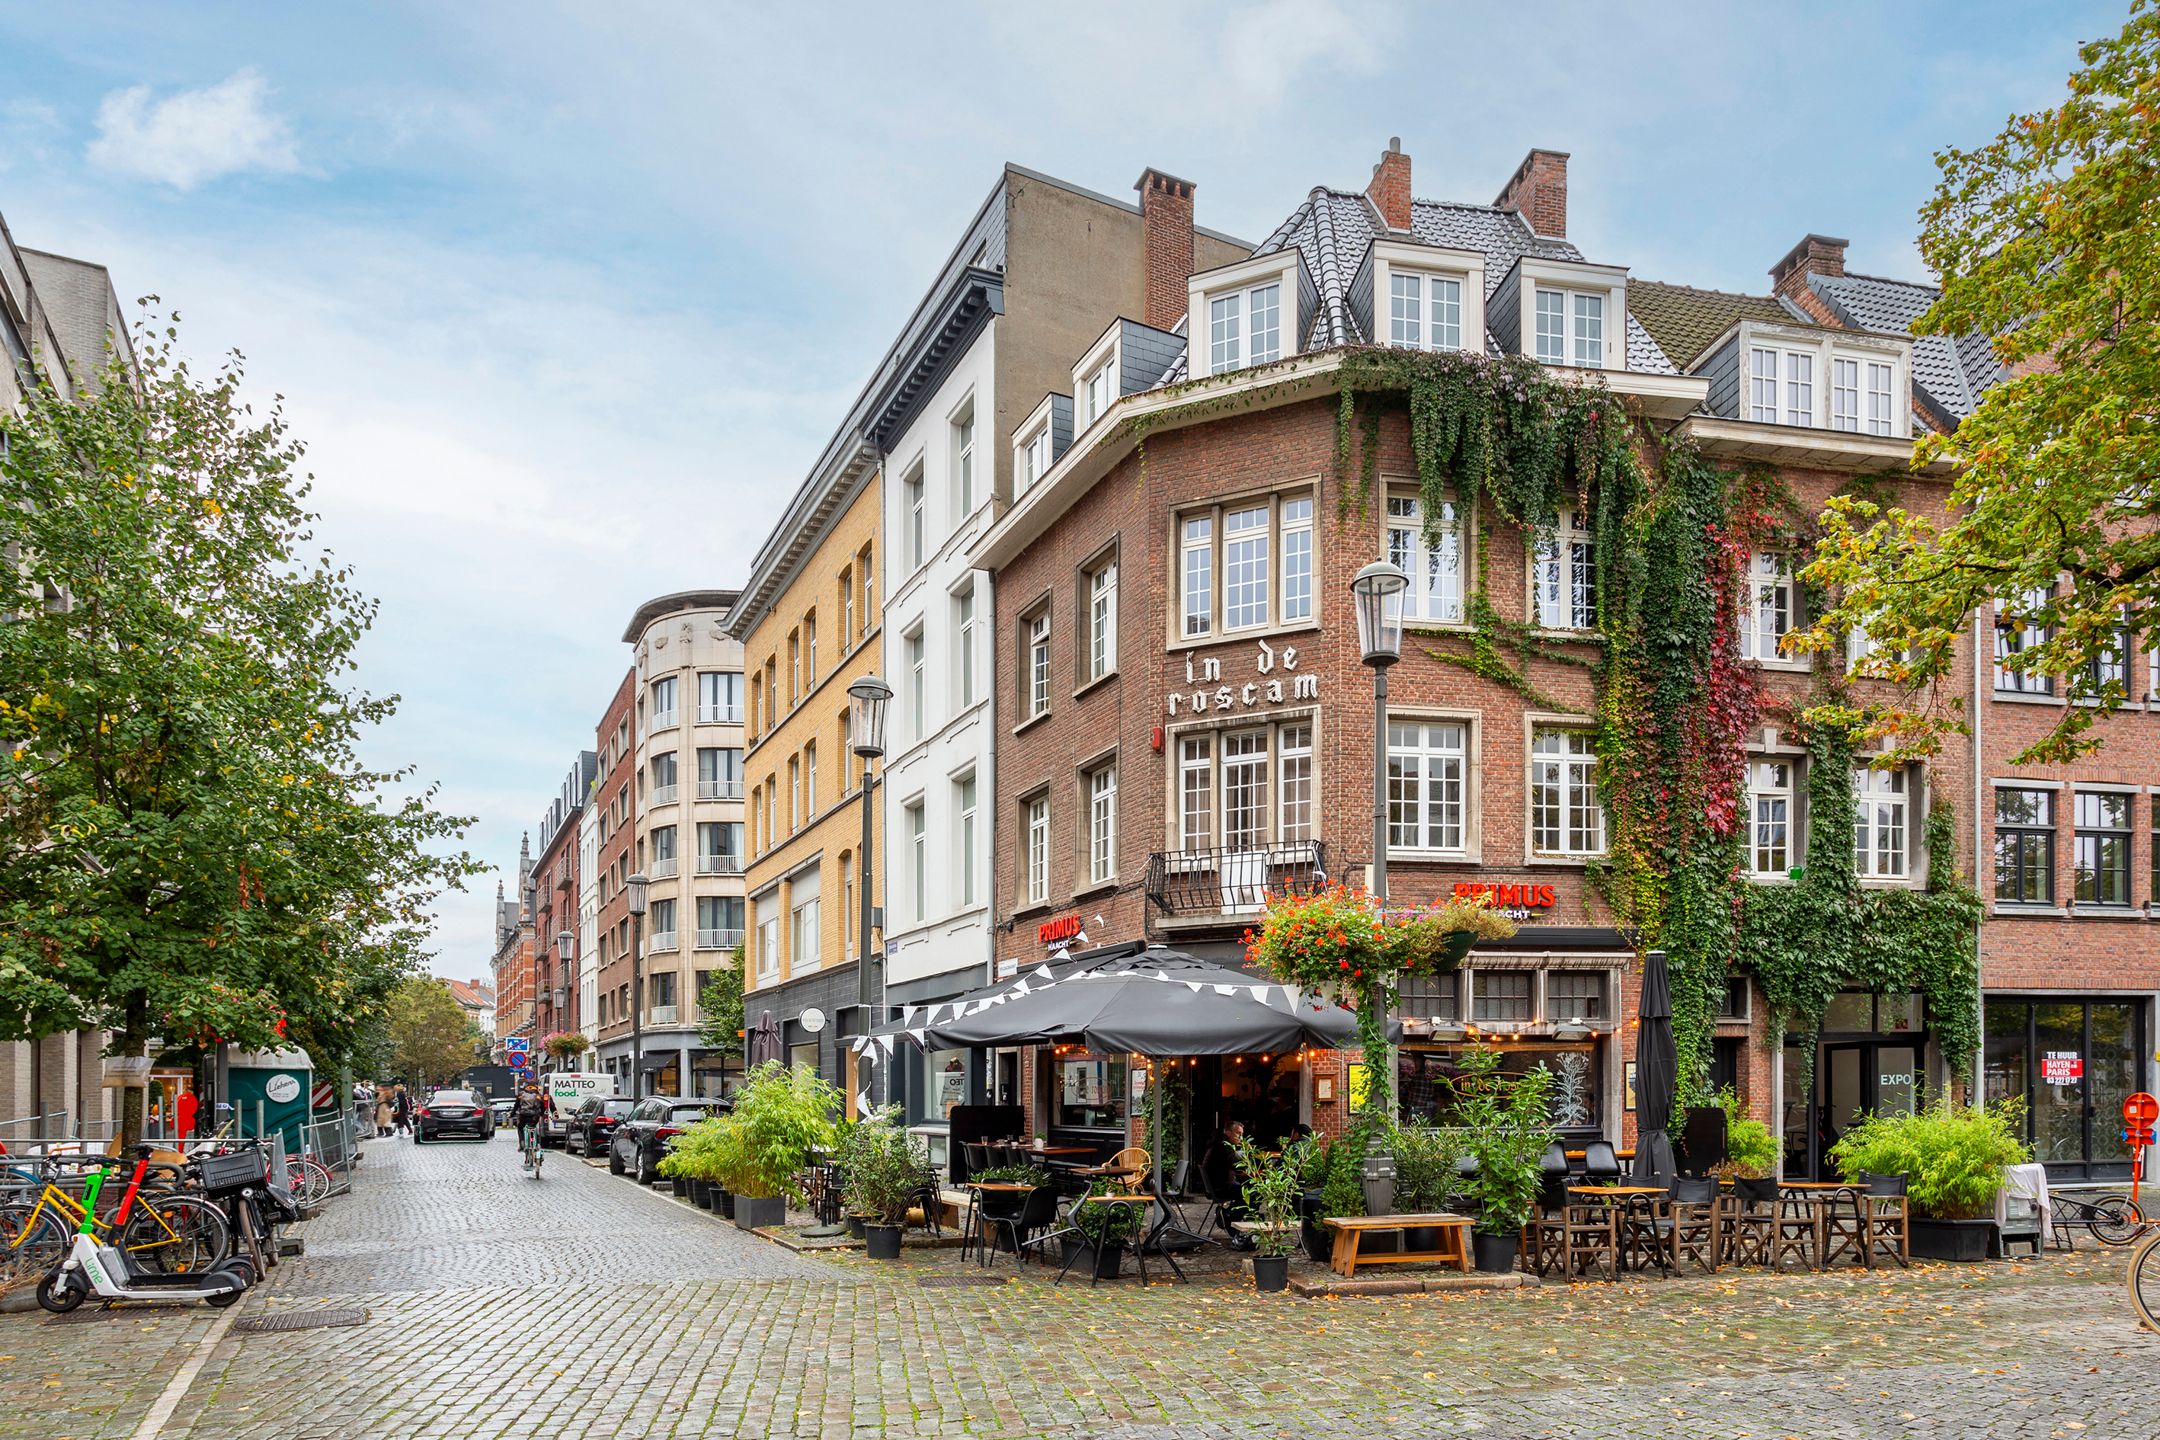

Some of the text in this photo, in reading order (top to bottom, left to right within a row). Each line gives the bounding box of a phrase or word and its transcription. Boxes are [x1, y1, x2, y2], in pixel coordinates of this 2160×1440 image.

[1185, 638, 1298, 685] in de
[1167, 673, 1319, 717] roscam
[1454, 883, 1556, 908] PRIMUS
[1038, 914, 1081, 944] PRIMUS
[2046, 1051, 2077, 1059] TE HUUR
[554, 1080, 595, 1089] MATTEO
[1880, 1074, 1912, 1085] EXPO
[554, 1089, 579, 1097] food.
